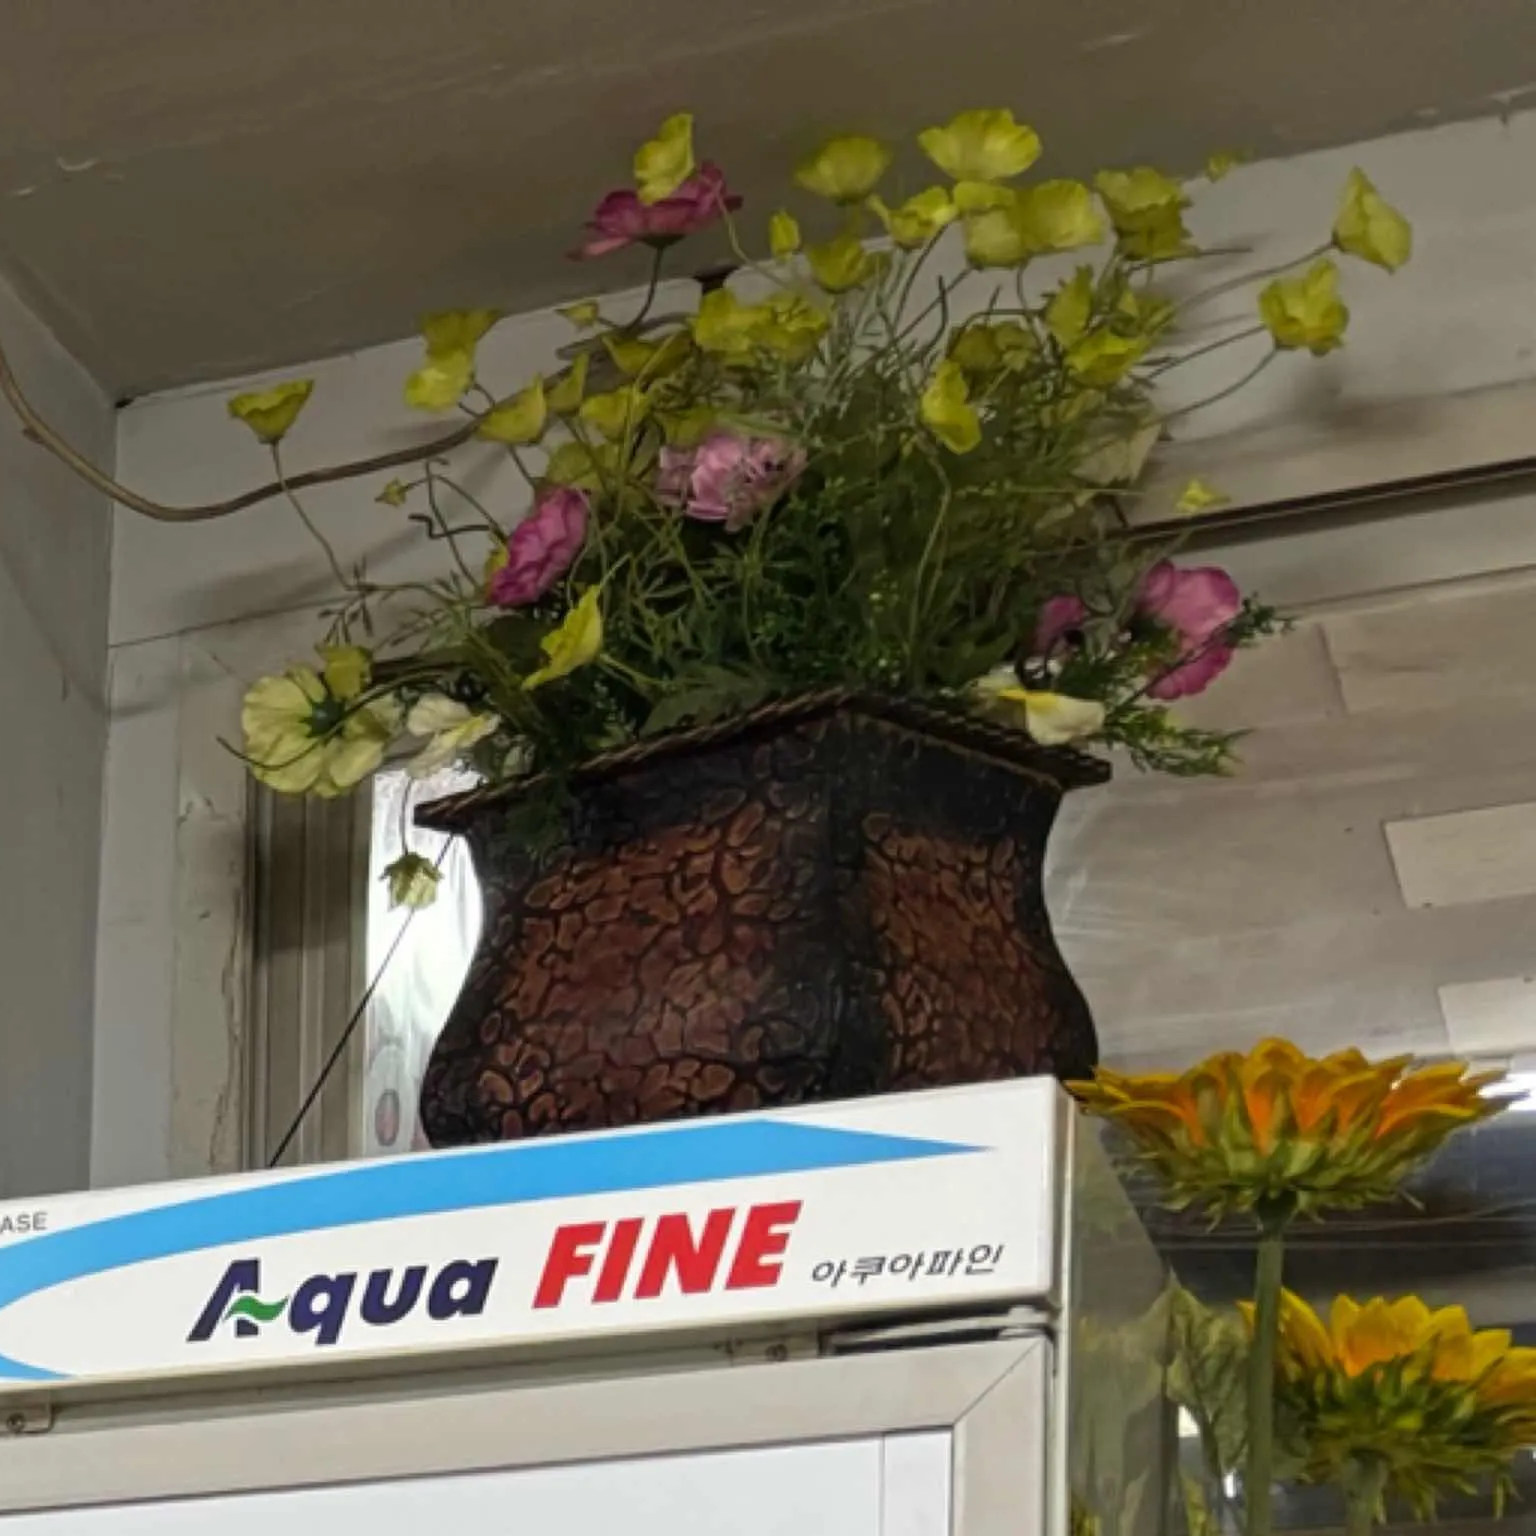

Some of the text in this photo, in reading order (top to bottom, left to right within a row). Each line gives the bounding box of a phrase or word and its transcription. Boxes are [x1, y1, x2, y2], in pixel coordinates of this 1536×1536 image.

[186, 1199, 1006, 1346] Aqua FINE 아쿠아파인
